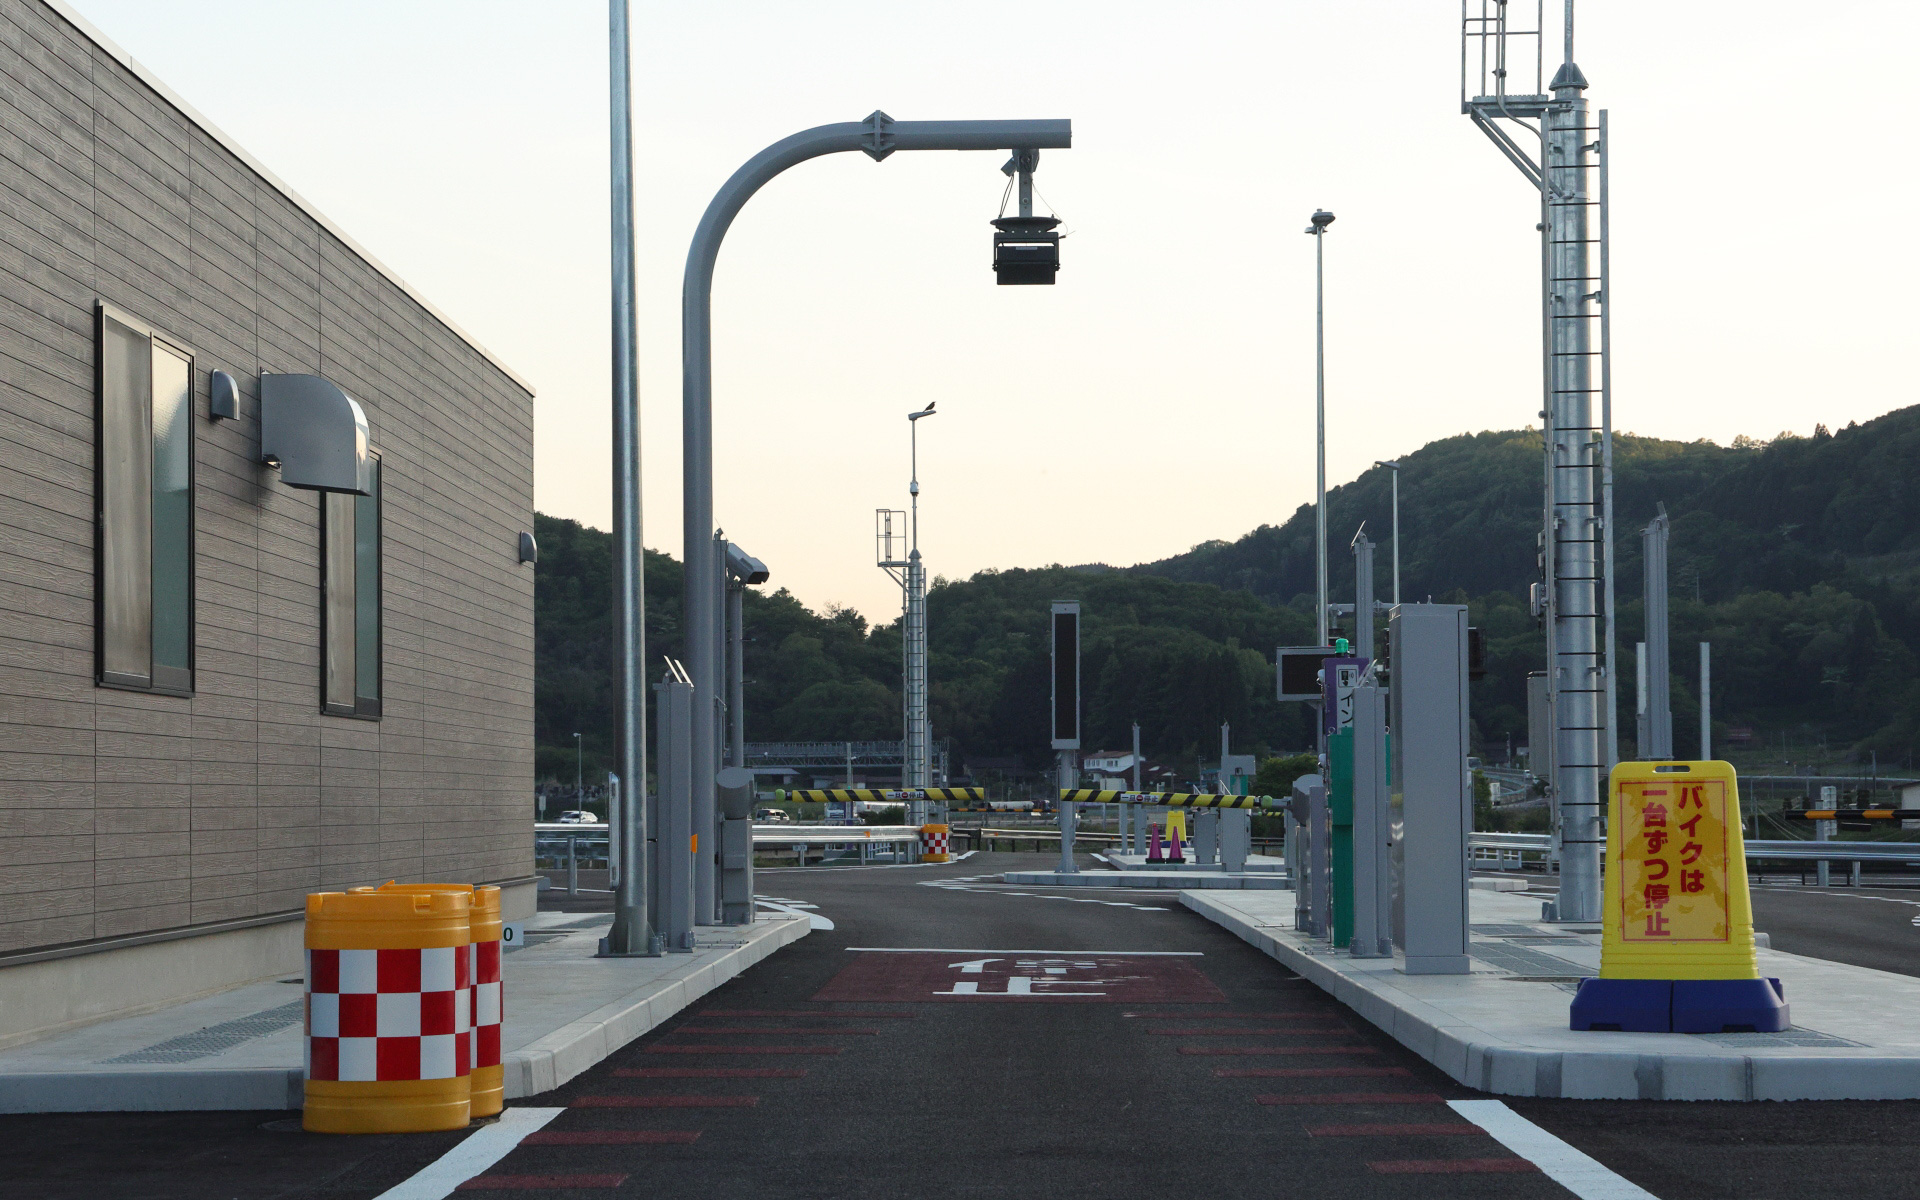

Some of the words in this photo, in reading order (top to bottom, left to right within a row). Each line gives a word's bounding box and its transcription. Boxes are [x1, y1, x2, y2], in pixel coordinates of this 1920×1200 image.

[1641, 788, 1671, 937] 一台ずつ停止
[1678, 785, 1705, 894] バイクは
